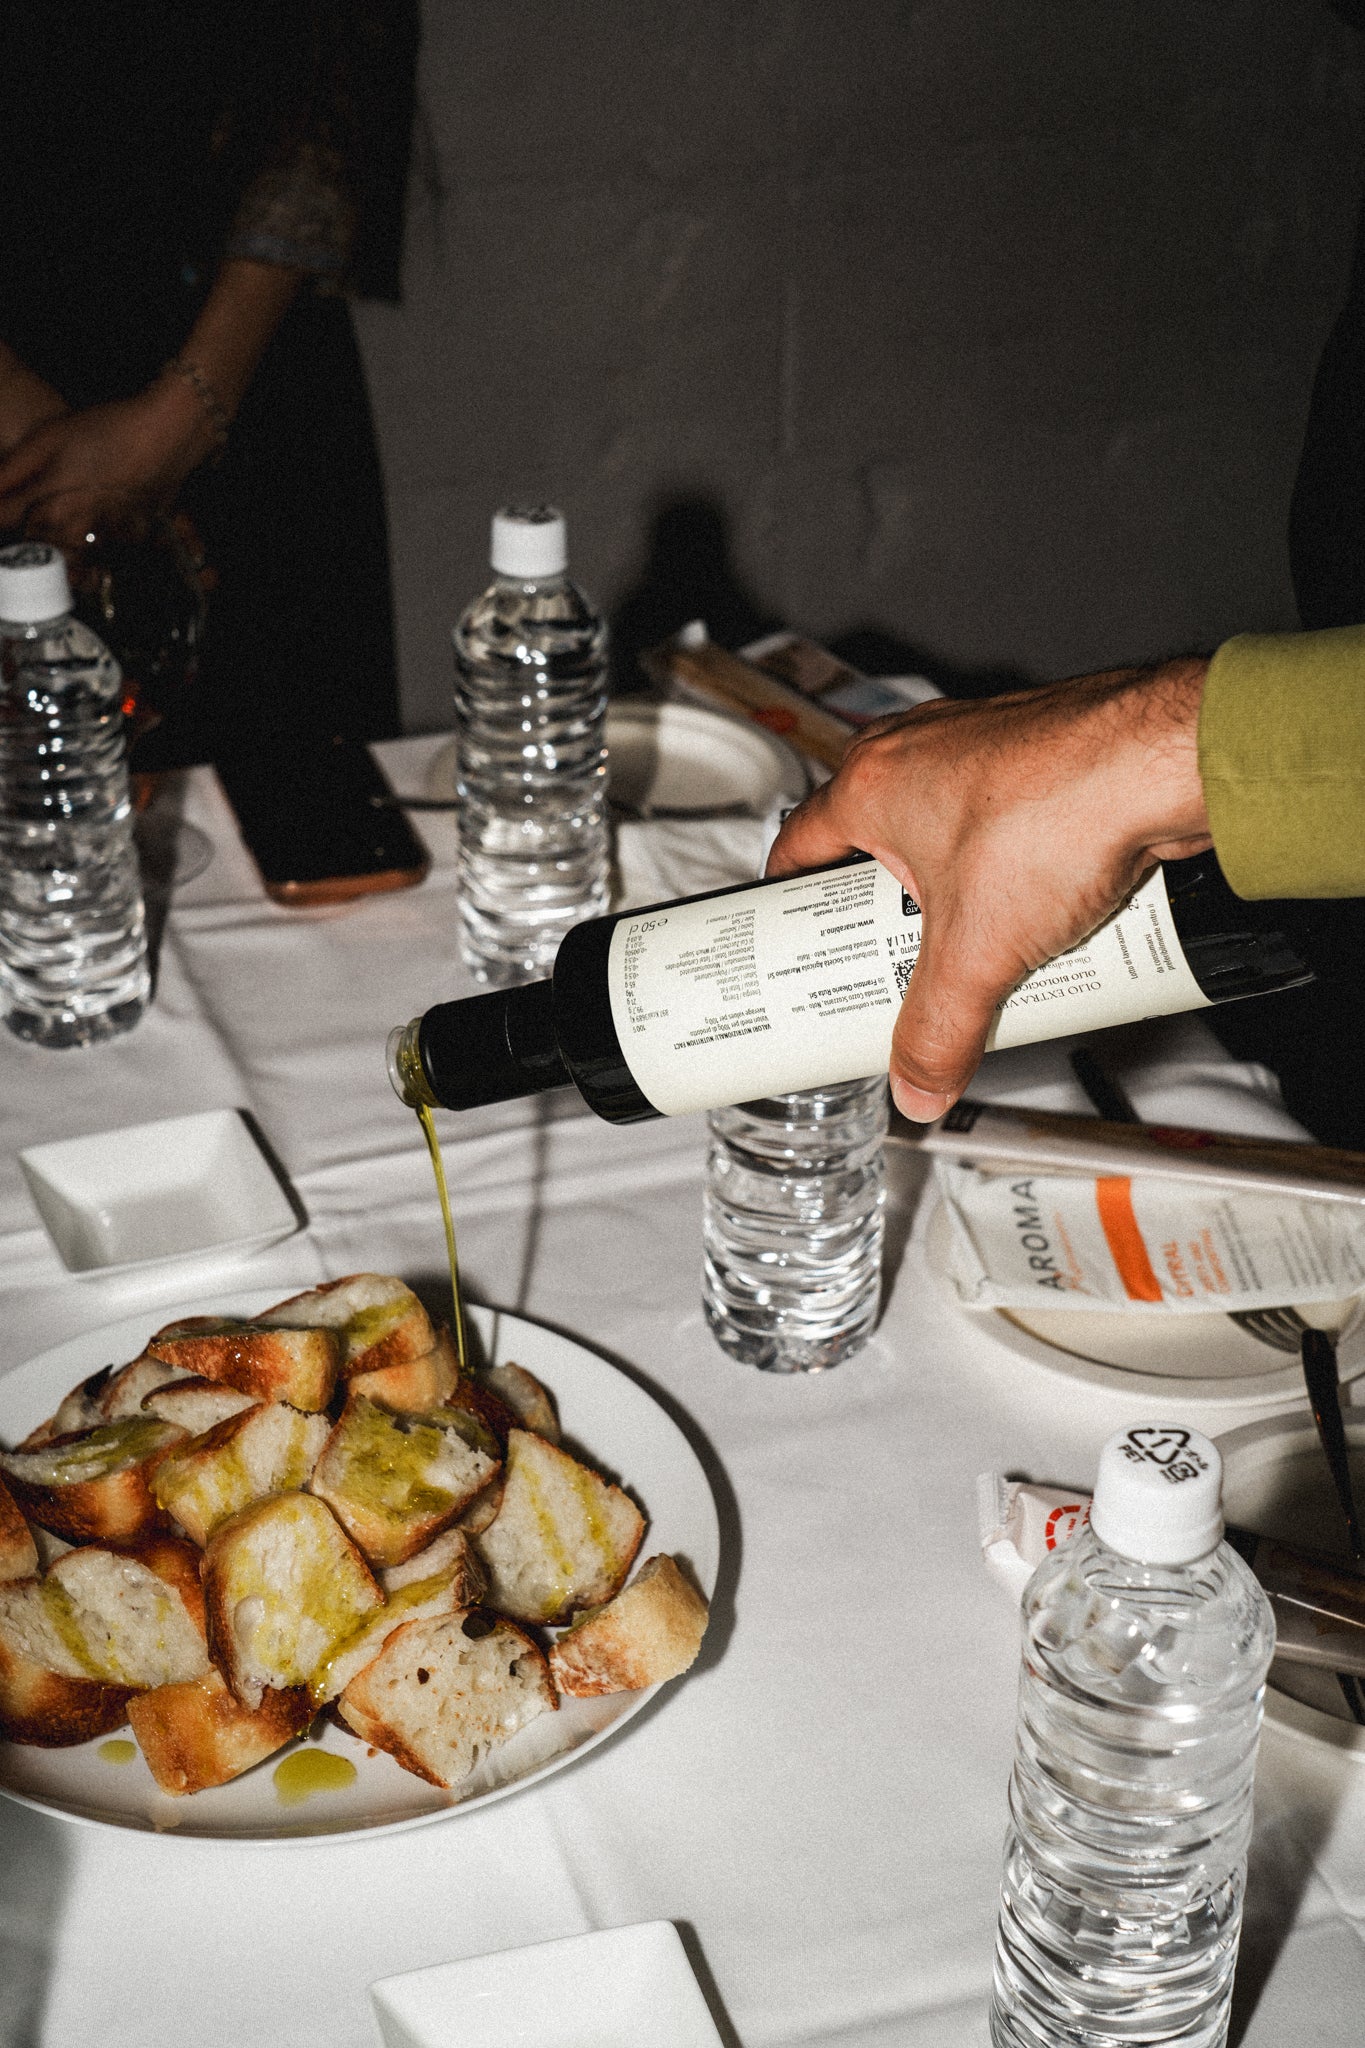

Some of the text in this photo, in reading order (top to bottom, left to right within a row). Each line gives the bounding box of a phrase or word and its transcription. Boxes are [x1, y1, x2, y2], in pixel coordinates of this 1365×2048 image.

[1150, 909, 1158, 925] entro
[820, 919, 874, 937] www.marabino.it
[1113, 923, 1129, 958] lavorazione
[1153, 927, 1175, 970] preferibilmente
[1144, 933, 1162, 965] consumarsi
[1047, 962, 1065, 970] oliva
[1074, 956, 1092, 964] Olio
[1128, 966, 1138, 979] Lotto
[832, 984, 853, 993] Oleario
[853, 979, 878, 988] Frantoio
[1013, 970, 1096, 993] OLIO BIOLOGICO
[1067, 981, 1102, 995] OLIO
[1020, 988, 1065, 1004] EXTRA
[1011, 1180, 1066, 1292] AROMA
[1118, 1444, 1146, 1463] PET
